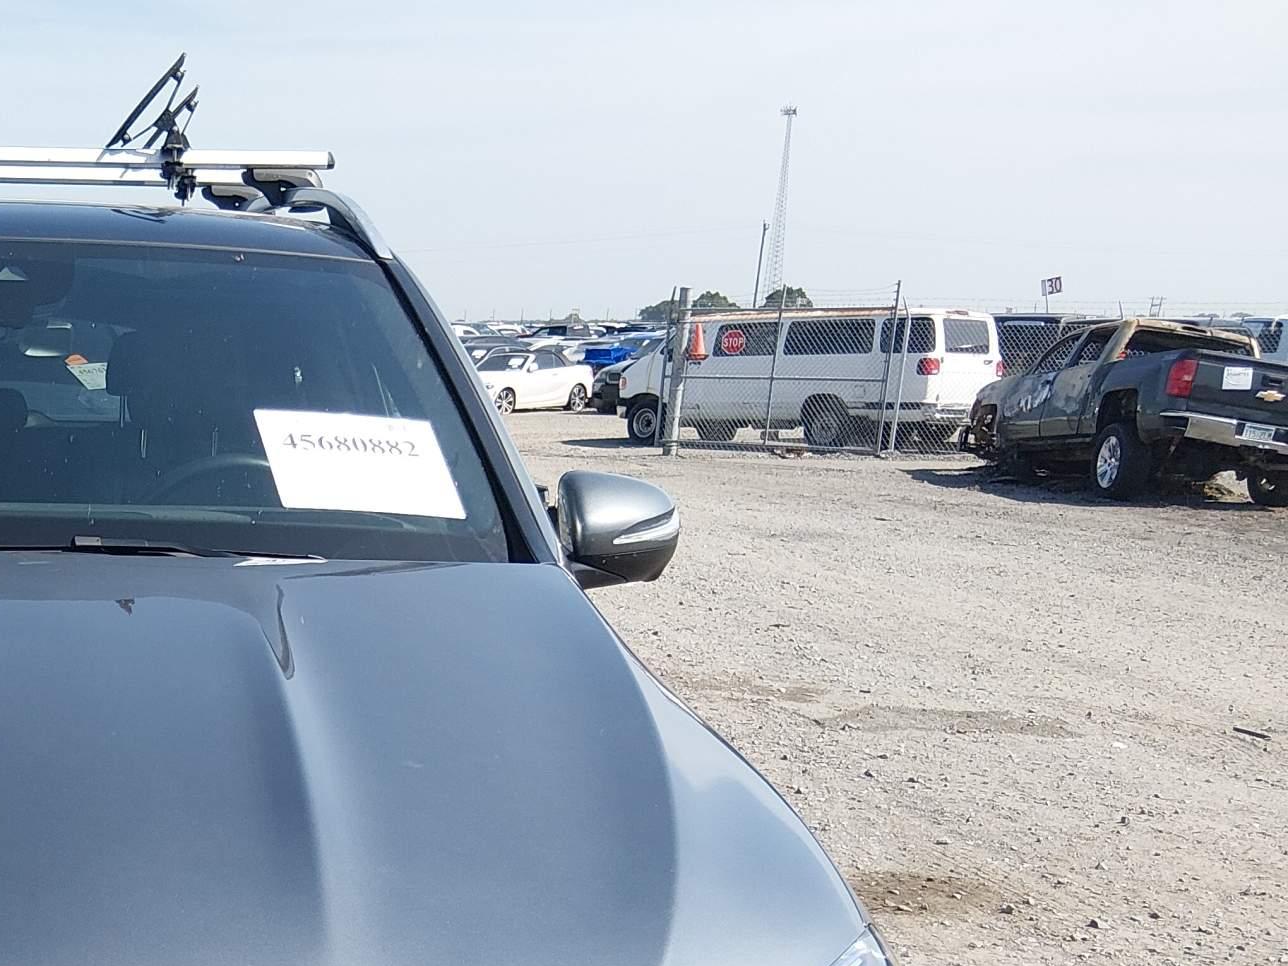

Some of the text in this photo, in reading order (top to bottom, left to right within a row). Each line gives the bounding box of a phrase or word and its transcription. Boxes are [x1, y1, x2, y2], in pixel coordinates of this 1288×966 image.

[1047, 276, 1062, 295] 30
[723, 337, 744, 348] STOP
[283, 433, 420, 457] 45680882
